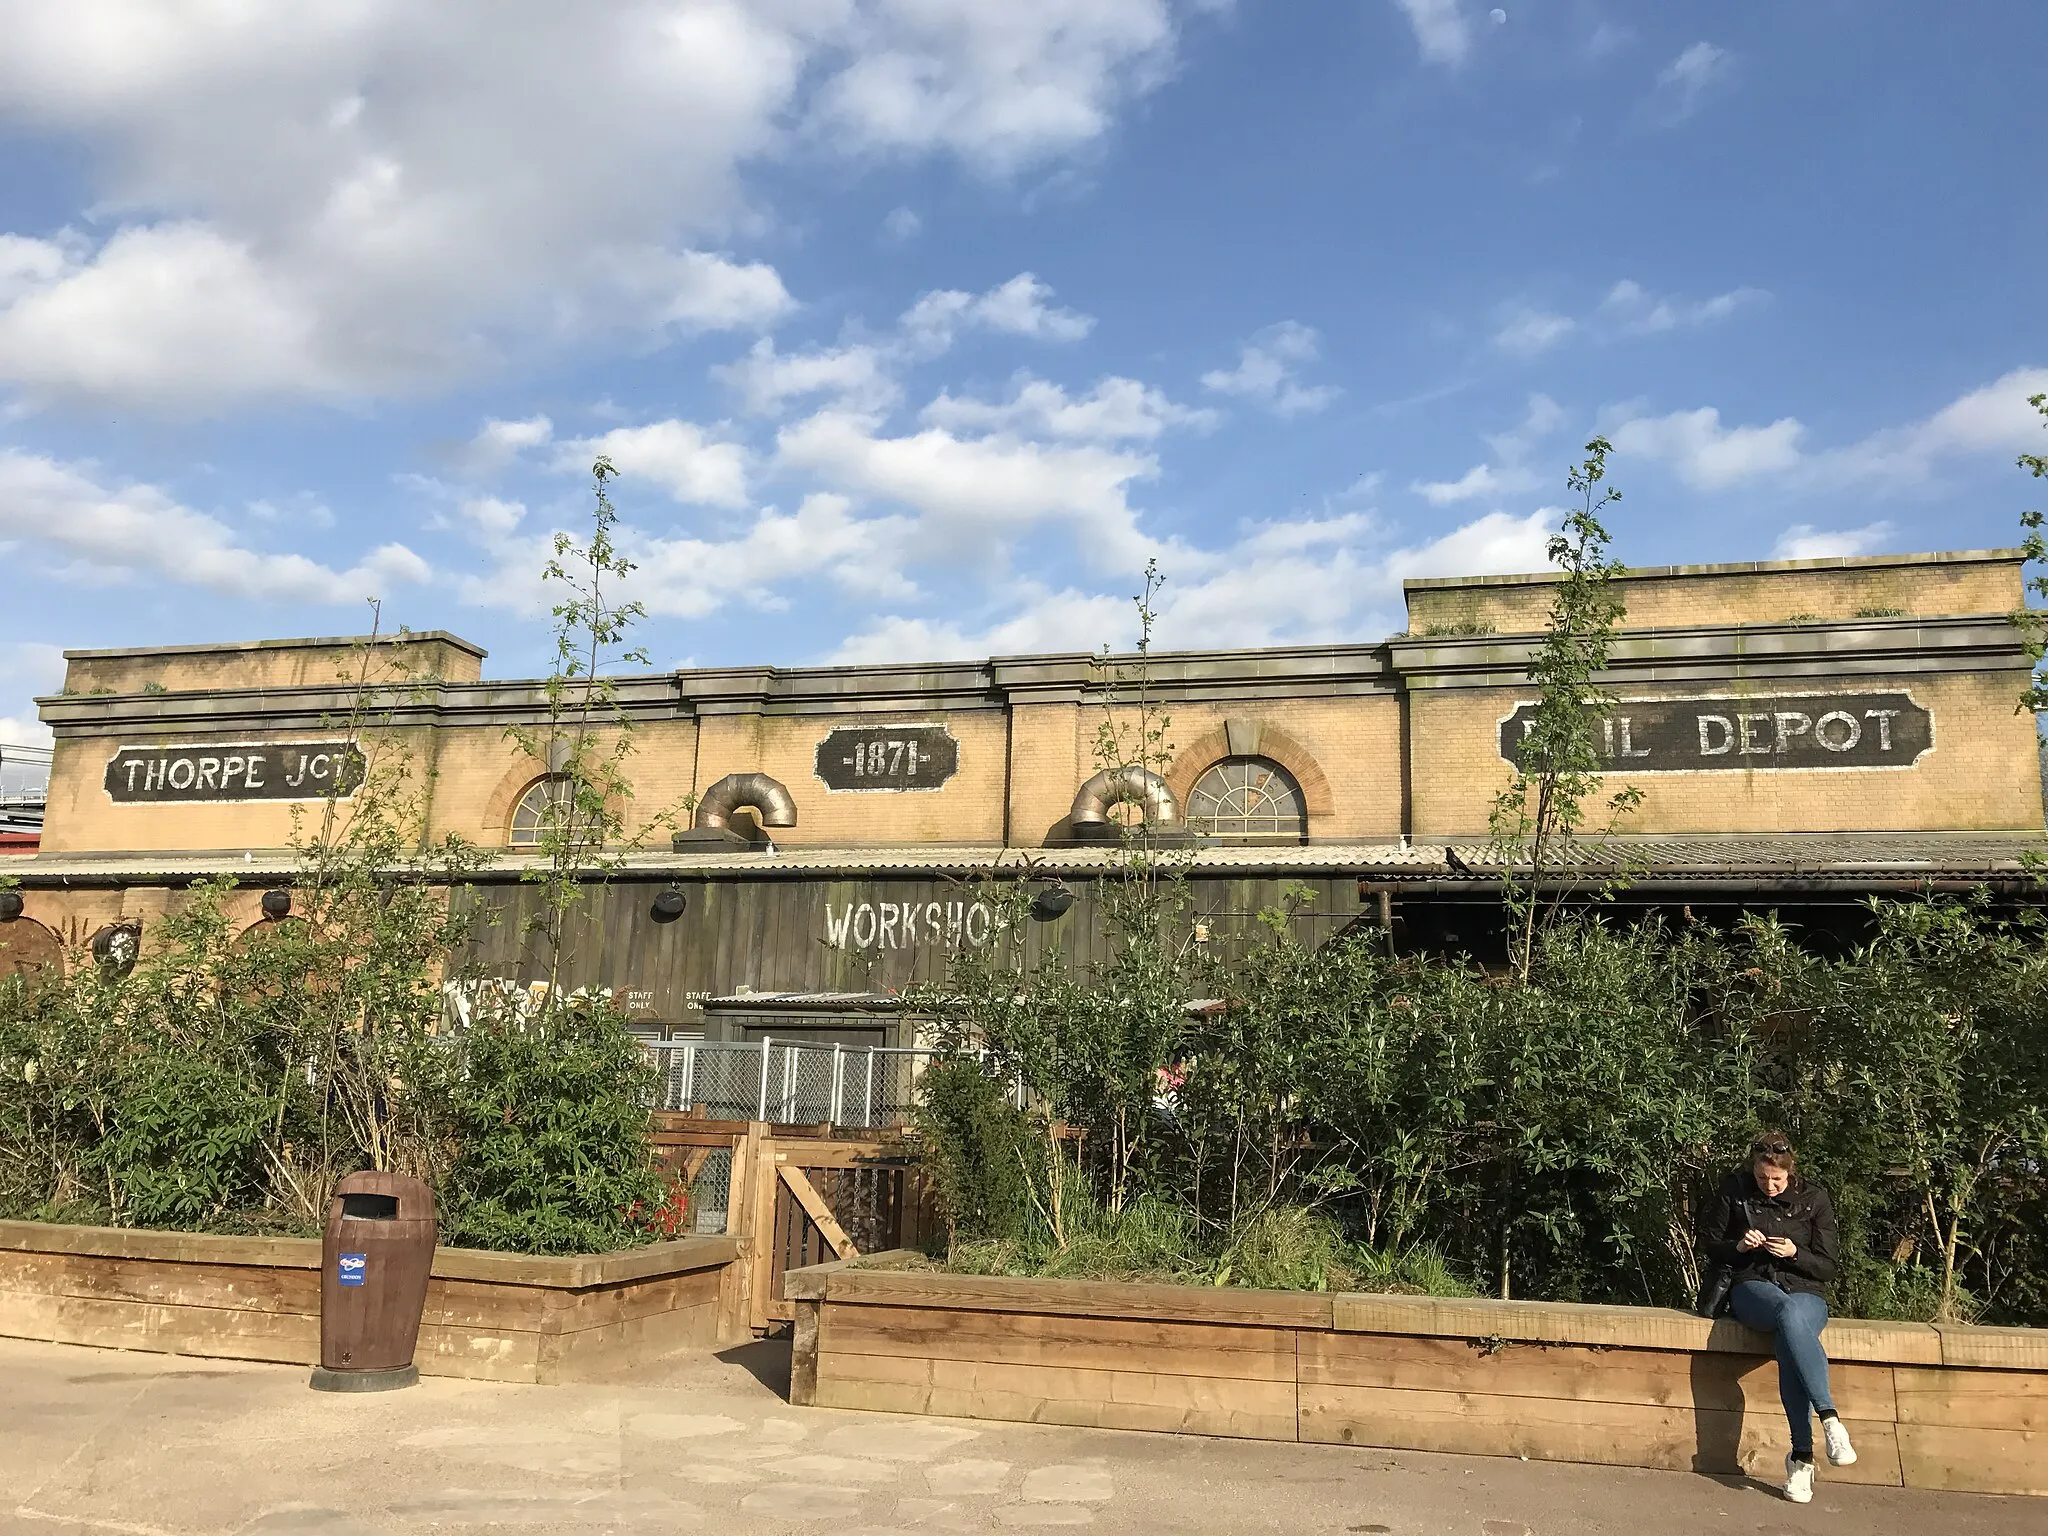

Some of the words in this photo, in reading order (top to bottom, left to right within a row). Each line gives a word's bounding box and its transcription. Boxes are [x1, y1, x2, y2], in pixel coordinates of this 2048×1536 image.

[1696, 709, 1900, 755] DEPOT
[121, 755, 266, 792] THORPE
[628, 991, 653, 1000] STAFF
[685, 991, 712, 1001] STAFF
[629, 1001, 650, 1009] ONLY
